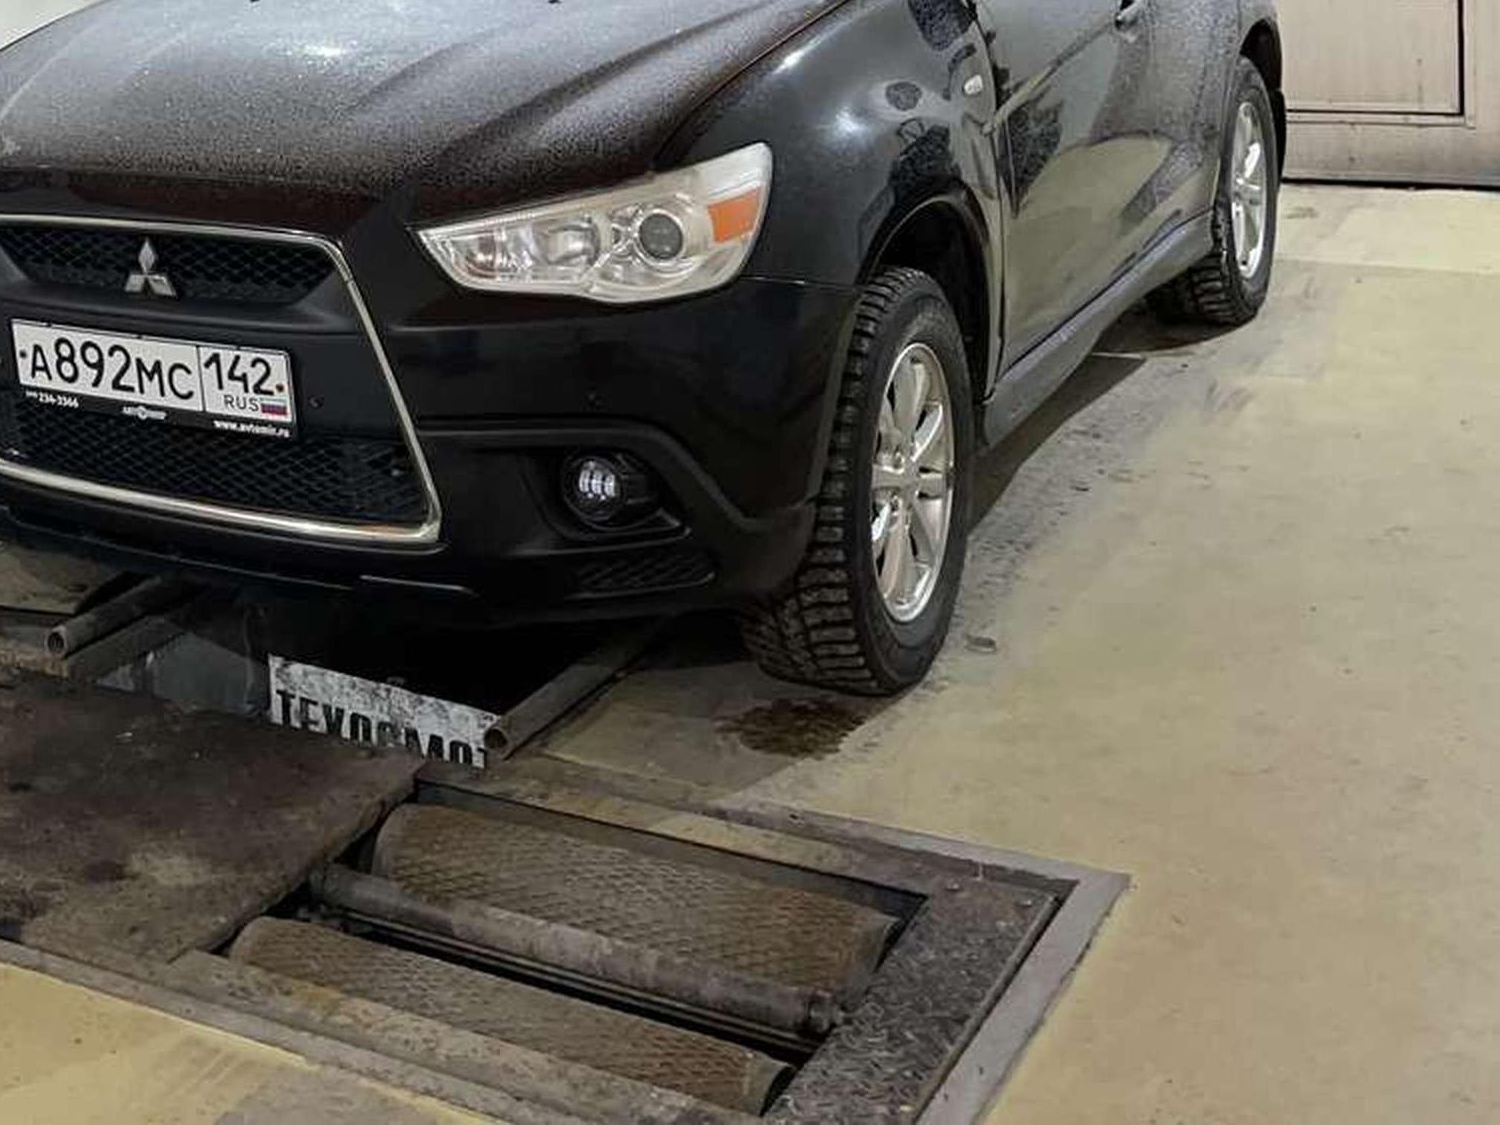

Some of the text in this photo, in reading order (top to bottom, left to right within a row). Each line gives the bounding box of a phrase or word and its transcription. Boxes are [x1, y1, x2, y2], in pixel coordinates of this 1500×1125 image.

[30, 337, 275, 401] А892МС 142
[224, 394, 259, 412] RUS
